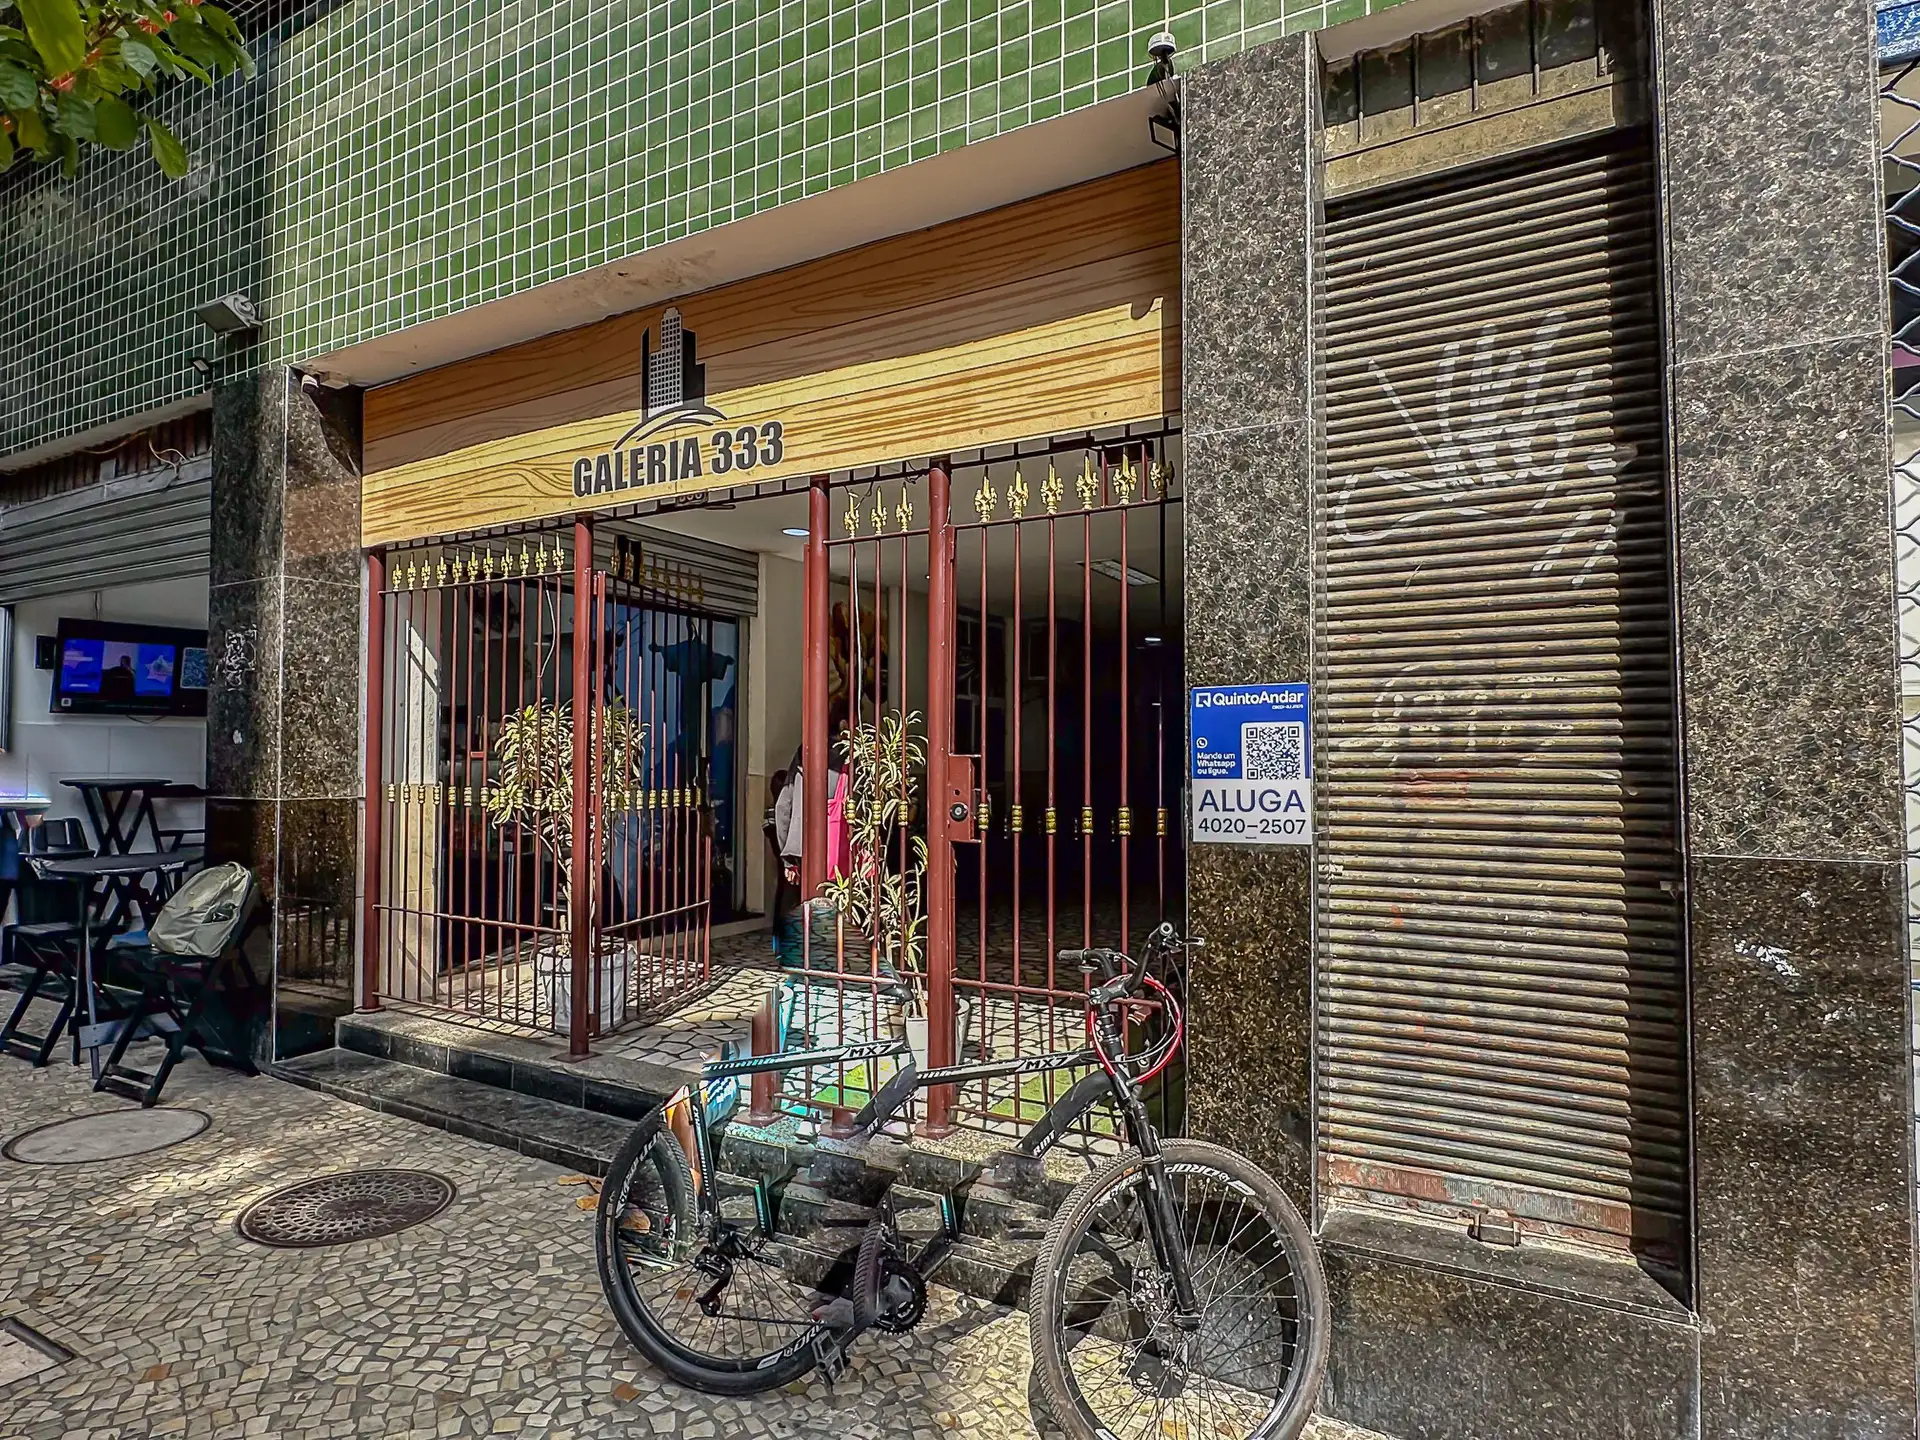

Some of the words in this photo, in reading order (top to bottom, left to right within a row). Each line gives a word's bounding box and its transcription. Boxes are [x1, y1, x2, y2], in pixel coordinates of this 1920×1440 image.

[573, 437, 703, 498] GALERIA
[711, 421, 784, 475] 333
[1212, 690, 1304, 706] QuintoAndar
[1197, 752, 1222, 760] Mande
[1197, 760, 1236, 768] Whatsapp
[1208, 766, 1229, 776] ligue.
[1198, 789, 1306, 813] ALUGA
[1198, 818, 1307, 835] 4020-2507
[850, 1044, 892, 1058] MX7
[1025, 1056, 1068, 1070] MX7
[1163, 1162, 1221, 1178] DROP
